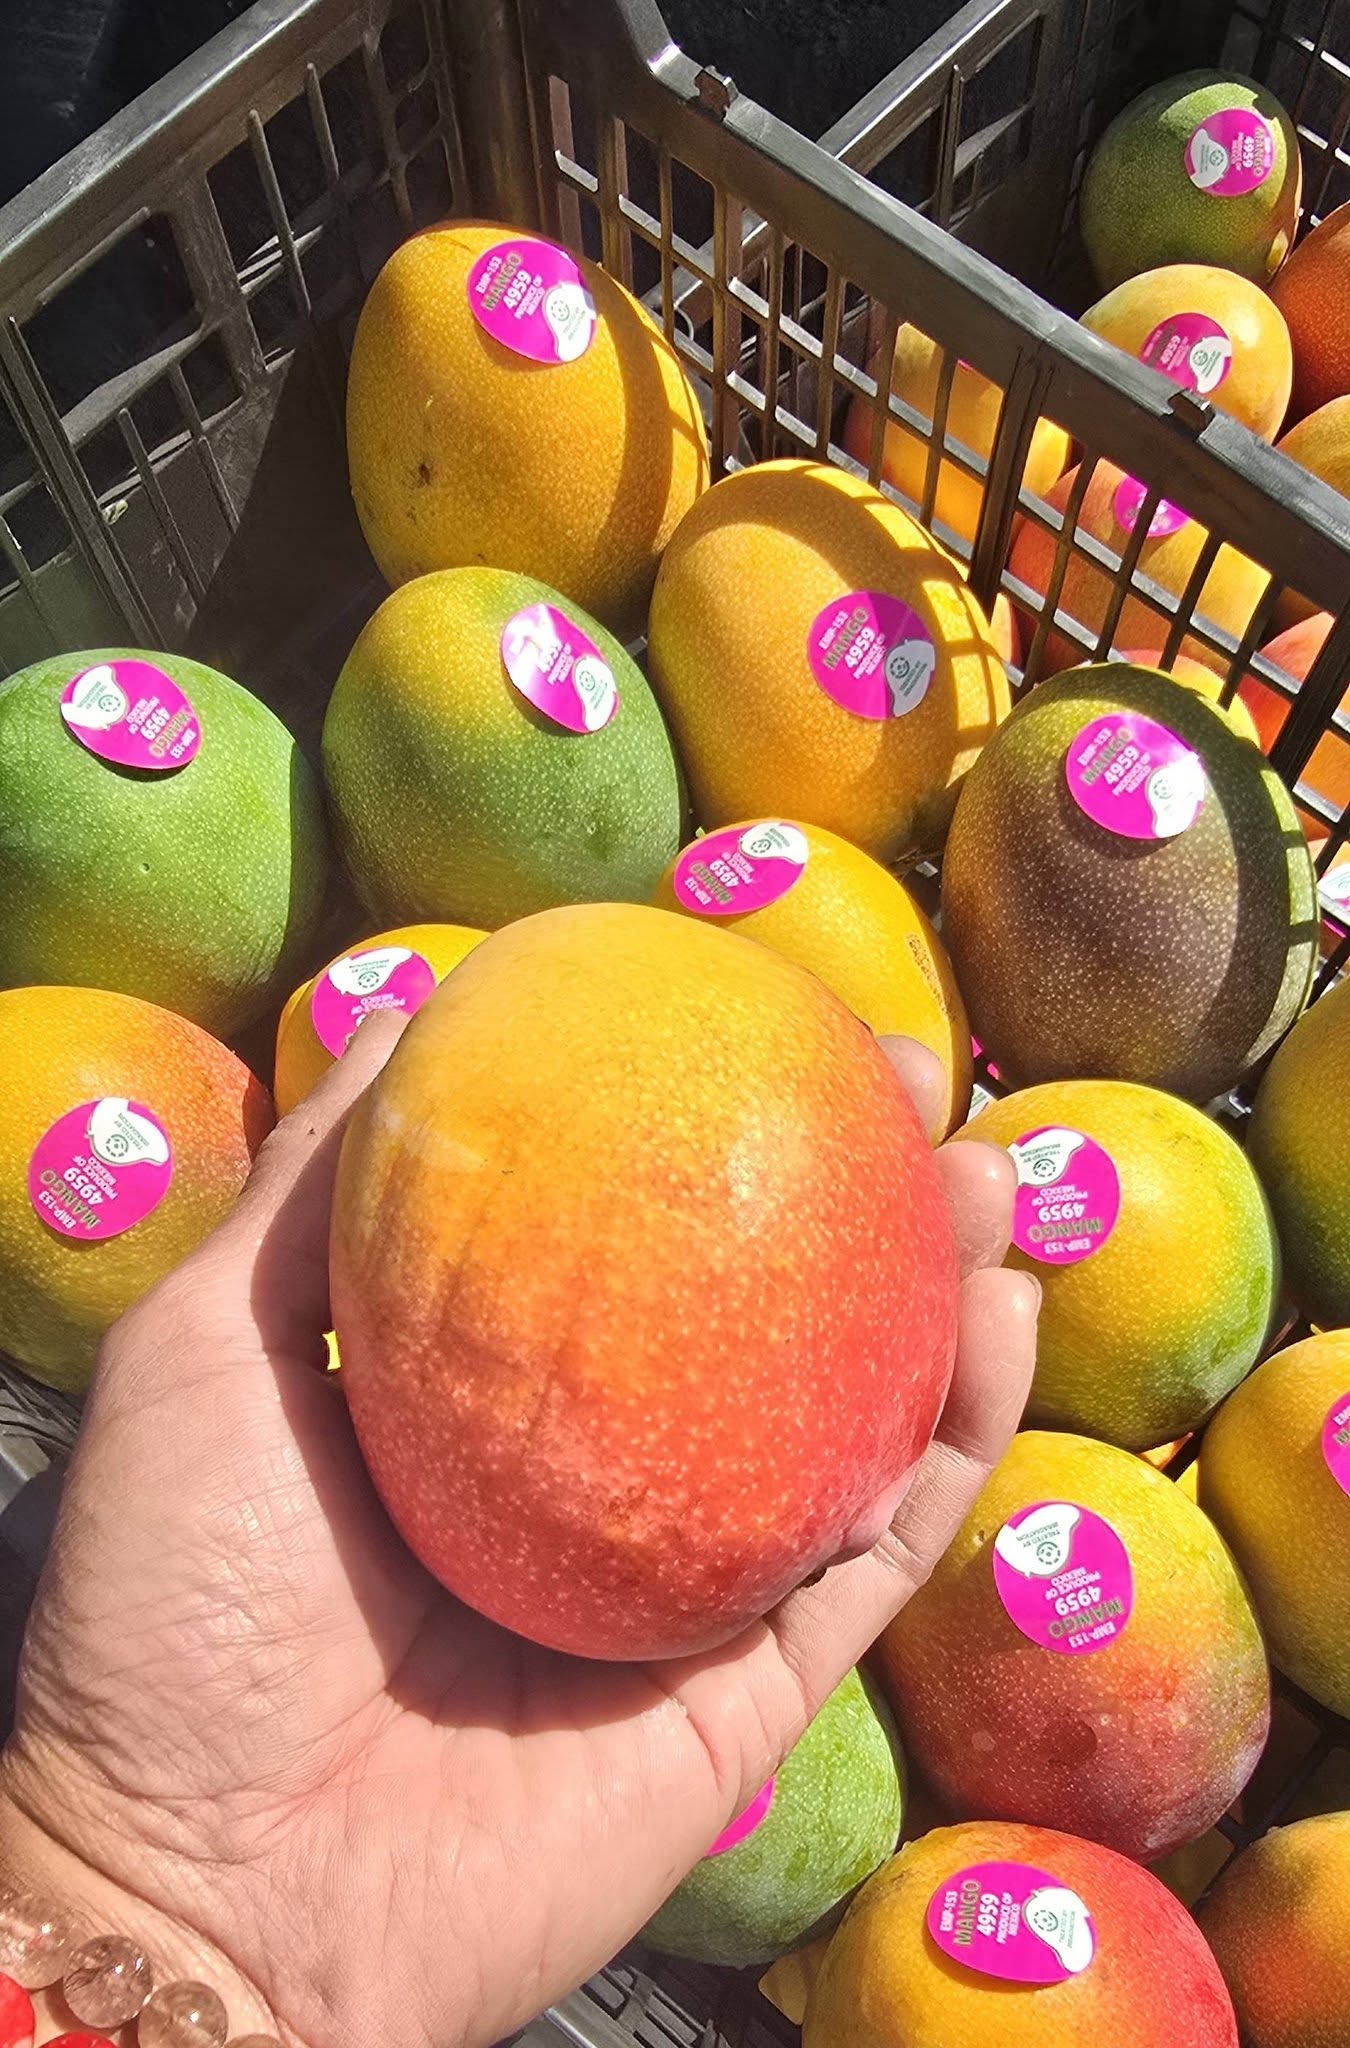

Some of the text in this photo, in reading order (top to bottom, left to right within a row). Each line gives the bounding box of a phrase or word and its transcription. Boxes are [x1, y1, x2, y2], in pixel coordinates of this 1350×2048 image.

[1243, 136, 1254, 168] 4959
[475, 256, 502, 294] EMP-153
[481, 252, 522, 311] MANGO
[503, 270, 531, 309] 4959
[533, 274, 543, 287] OF
[526, 287, 545, 316] MEXICO
[1161, 335, 1180, 364] 4959
[819, 611, 848, 650] EMP-153
[823, 607, 868, 670] MANGO
[845, 627, 875, 668] 4959
[557, 655, 574, 683] MEXICO
[125, 698, 149, 723] MEXICO
[140, 707, 171, 740] 4959
[128, 724, 139, 735] OF
[149, 709, 191, 758] MANGO
[1077, 728, 1112, 766] EMP-153
[1080, 727, 1133, 785] MANGO
[1140, 751, 1152, 764] OF
[1104, 745, 1139, 785] 4959
[1126, 765, 1151, 794] MEXICO
[689, 861, 733, 905] MANGO
[709, 859, 739, 888] 4959
[72, 1155, 86, 1167] OF
[87, 1156, 117, 1185] MEXICO
[40, 1169, 101, 1230] MANGO
[64, 1167, 104, 1205] 4959
[1040, 1185, 1075, 1197] MEXICO
[38, 1191, 77, 1229] EMP-153
[1031, 1197, 1044, 1207] OF
[1038, 1202, 1085, 1223] 4959
[1028, 1218, 1102, 1243] MANGO
[1044, 1238, 1091, 1254] EMP-153
[1051, 1567, 1087, 1586] MEXICO
[1045, 1590, 1058, 1600] OF
[1055, 1586, 1102, 1616] 4959
[1049, 1599, 1123, 1638] MANGO
[1068, 1621, 1116, 1648] EMP-153
[940, 1891, 958, 1932] EMP-153
[953, 1880, 981, 1945] MANGO
[1002, 1892, 1013, 1904] OF
[976, 1893, 1000, 1937] 4959
[1008, 1903, 1021, 1936] MEXICO
